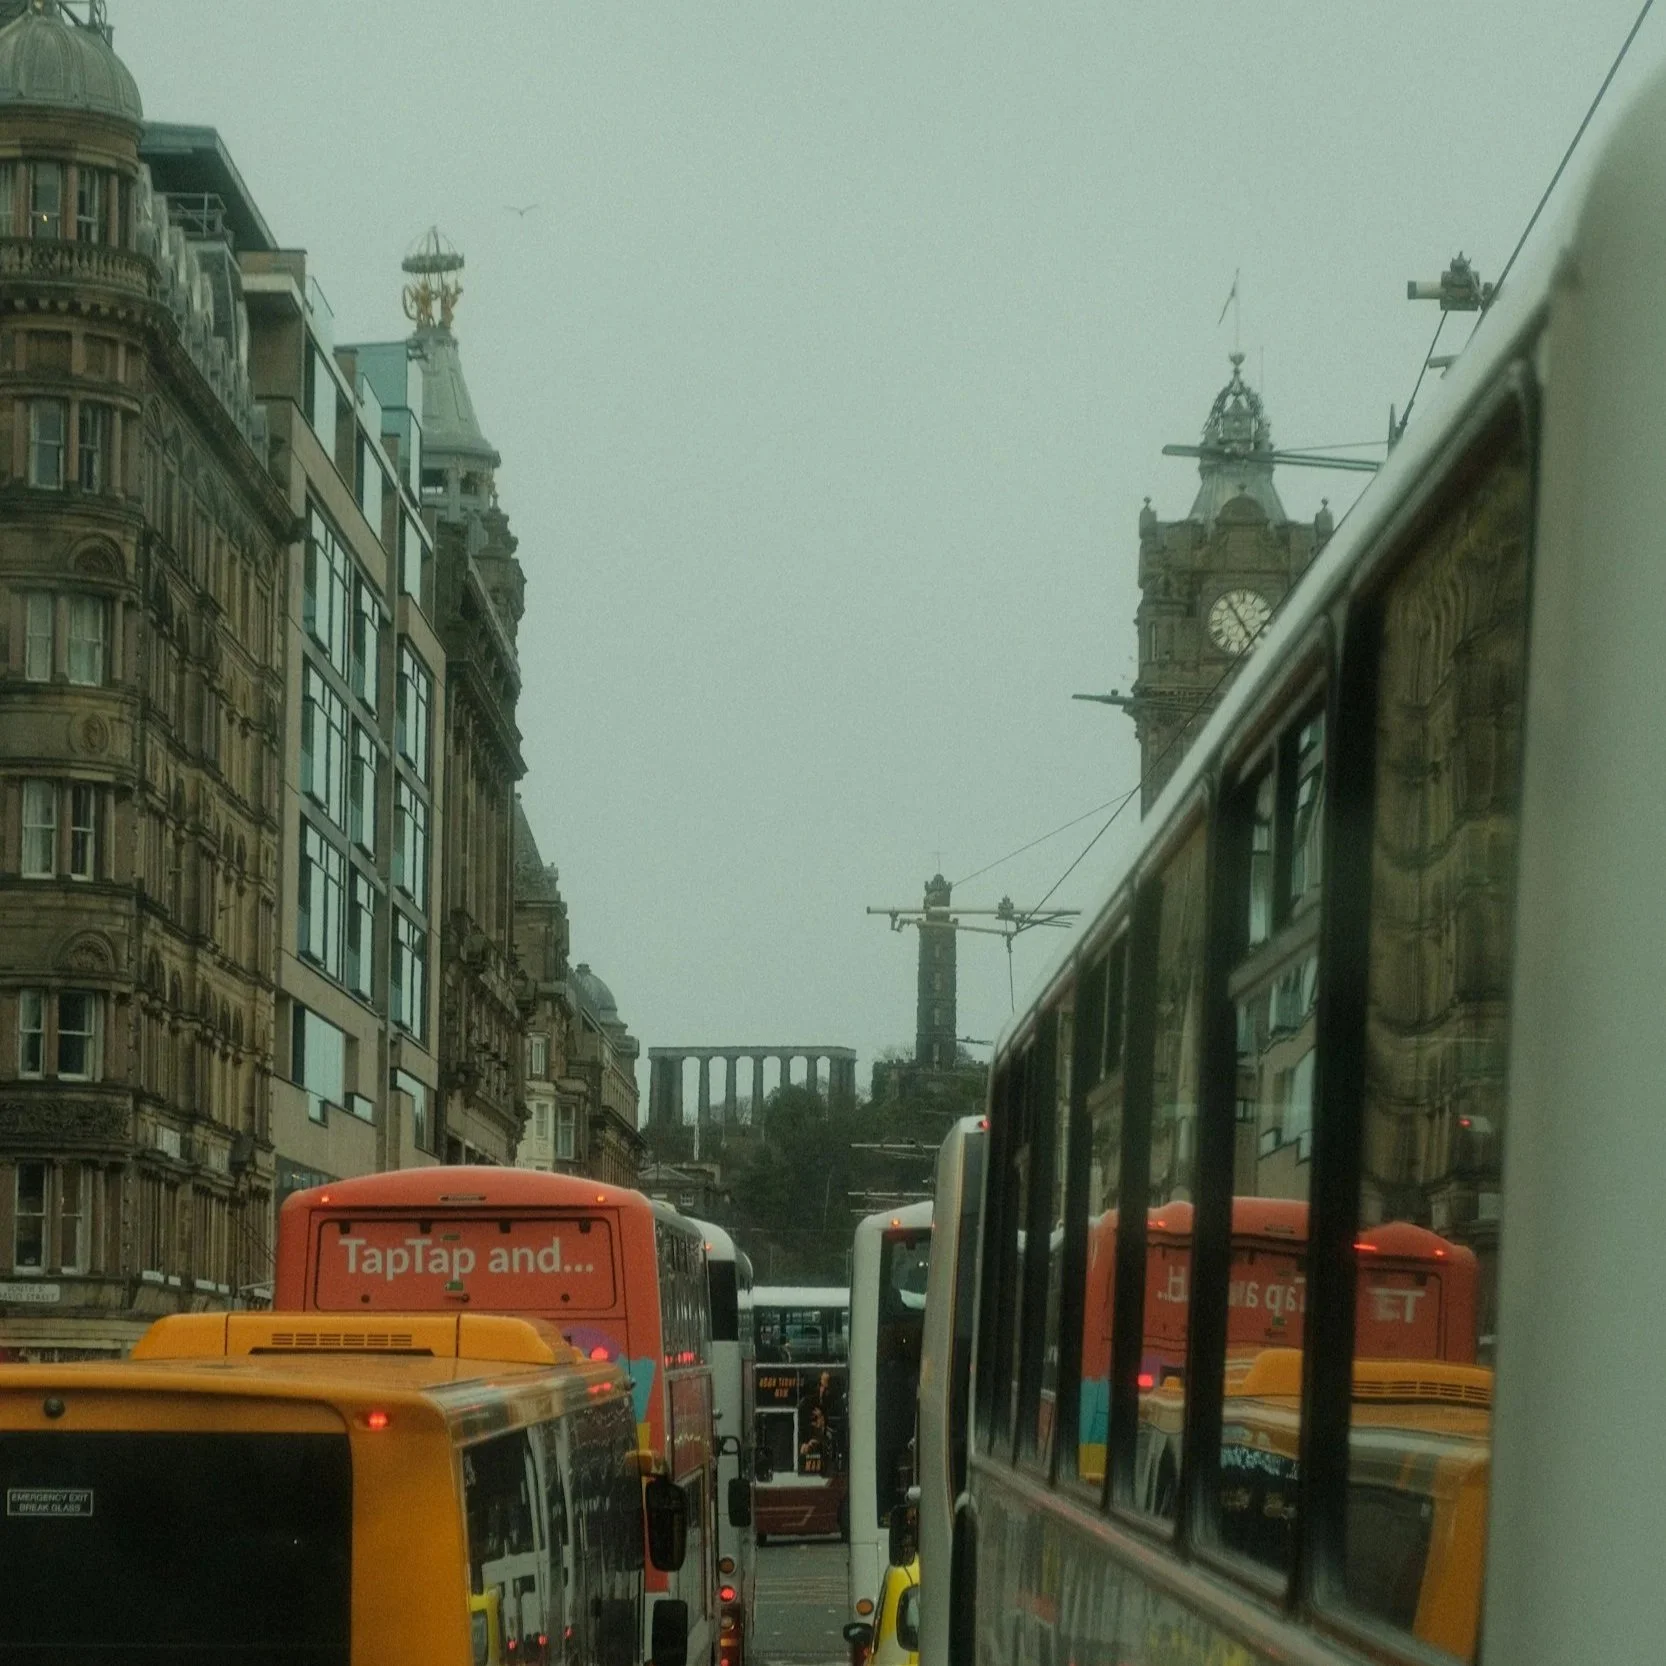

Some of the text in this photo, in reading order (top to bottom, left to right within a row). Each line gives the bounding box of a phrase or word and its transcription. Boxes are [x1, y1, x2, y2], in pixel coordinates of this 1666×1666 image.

[338, 1236, 594, 1281] TapTap and...
[11, 1493, 89, 1502] EMERGENCY EXIT
[19, 1503, 81, 1512] BREAK GLASS
